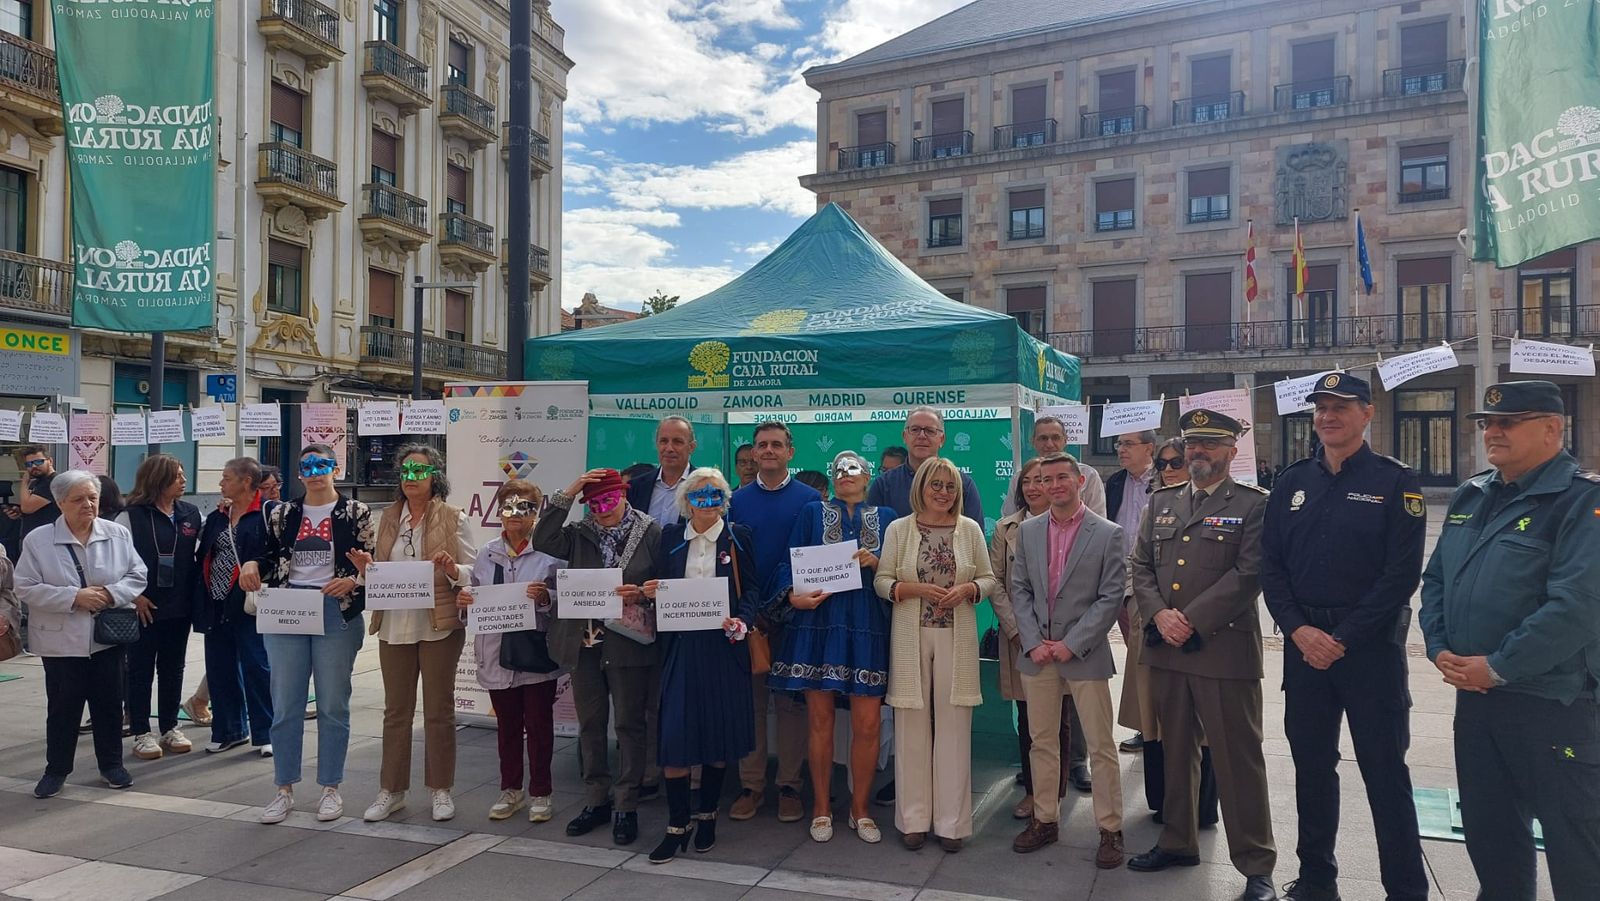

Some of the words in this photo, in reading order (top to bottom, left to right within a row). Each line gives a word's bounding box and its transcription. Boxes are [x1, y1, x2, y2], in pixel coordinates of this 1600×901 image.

[5, 332, 63, 352] ONCE
[732, 350, 819, 364] FUNDACION
[1523, 358, 1580, 366] DESAPARECE
[732, 365, 766, 378] CAJA
[770, 363, 819, 376] RURAL
[747, 378, 782, 388] ZAMORA
[217, 393, 236, 402] ATM
[616, 396, 699, 411] VALLADOLID
[722, 394, 784, 409] ZAMORA
[808, 393, 867, 407] MADRID
[892, 390, 966, 406] OURENSE
[1278, 392, 1297, 400] ERES
[295, 551, 331, 560] MINNIE
[296, 559, 330, 567] MOUSE
[807, 567, 823, 575] QUE
[823, 565, 834, 573] NO
[803, 572, 850, 584] INSEGURIDAD
[571, 590, 586, 598] QUE
[671, 601, 688, 609] QUE
[701, 600, 711, 608] SE
[477, 613, 524, 623] DIFICULTADES
[662, 610, 722, 619] INCERTIDUMBRE
[478, 622, 524, 632] ECONÓMICAS
